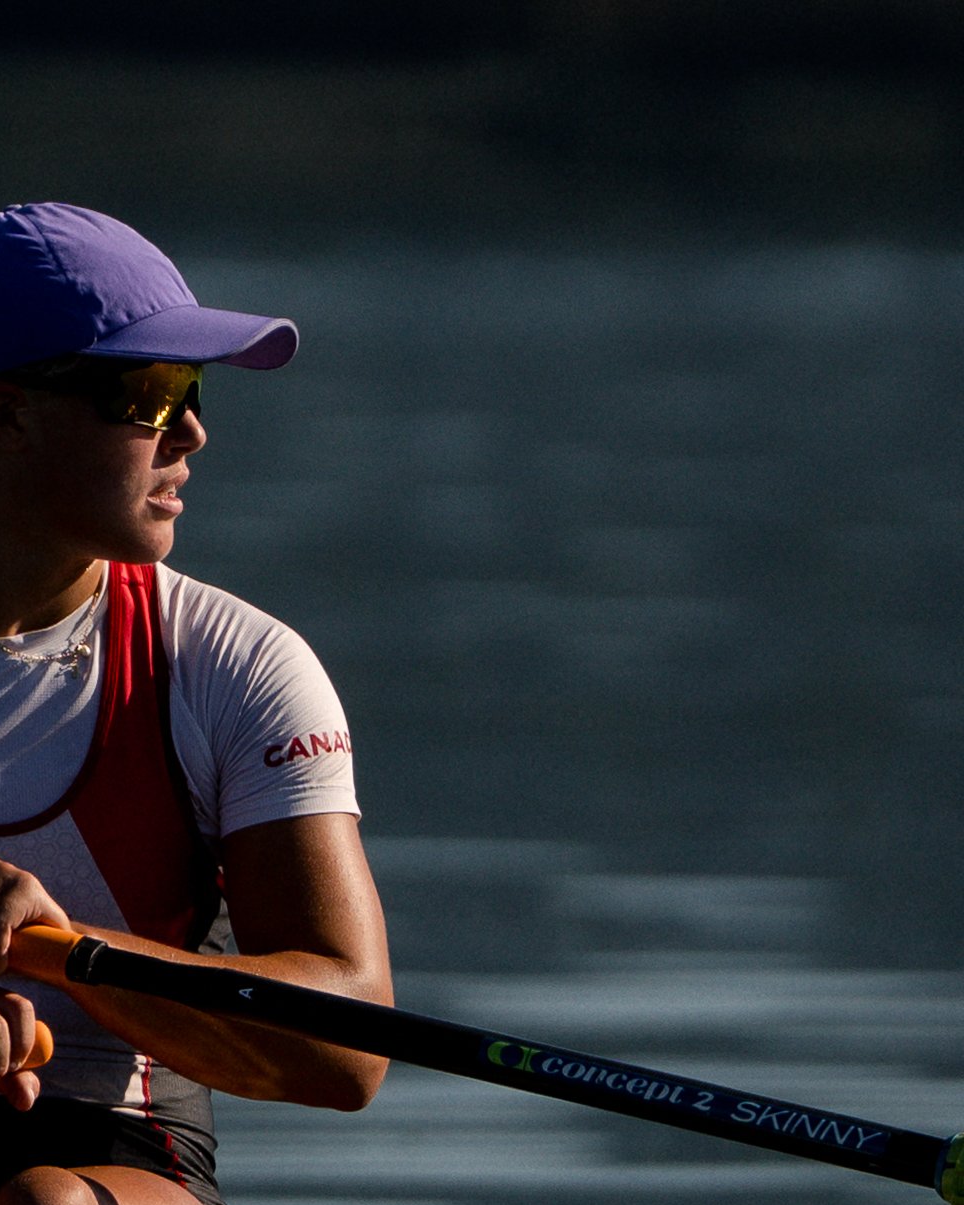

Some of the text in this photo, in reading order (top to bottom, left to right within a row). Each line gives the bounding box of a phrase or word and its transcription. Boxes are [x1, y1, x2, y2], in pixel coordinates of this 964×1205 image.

[542, 1055, 883, 1148] concept 2 SKINNY
